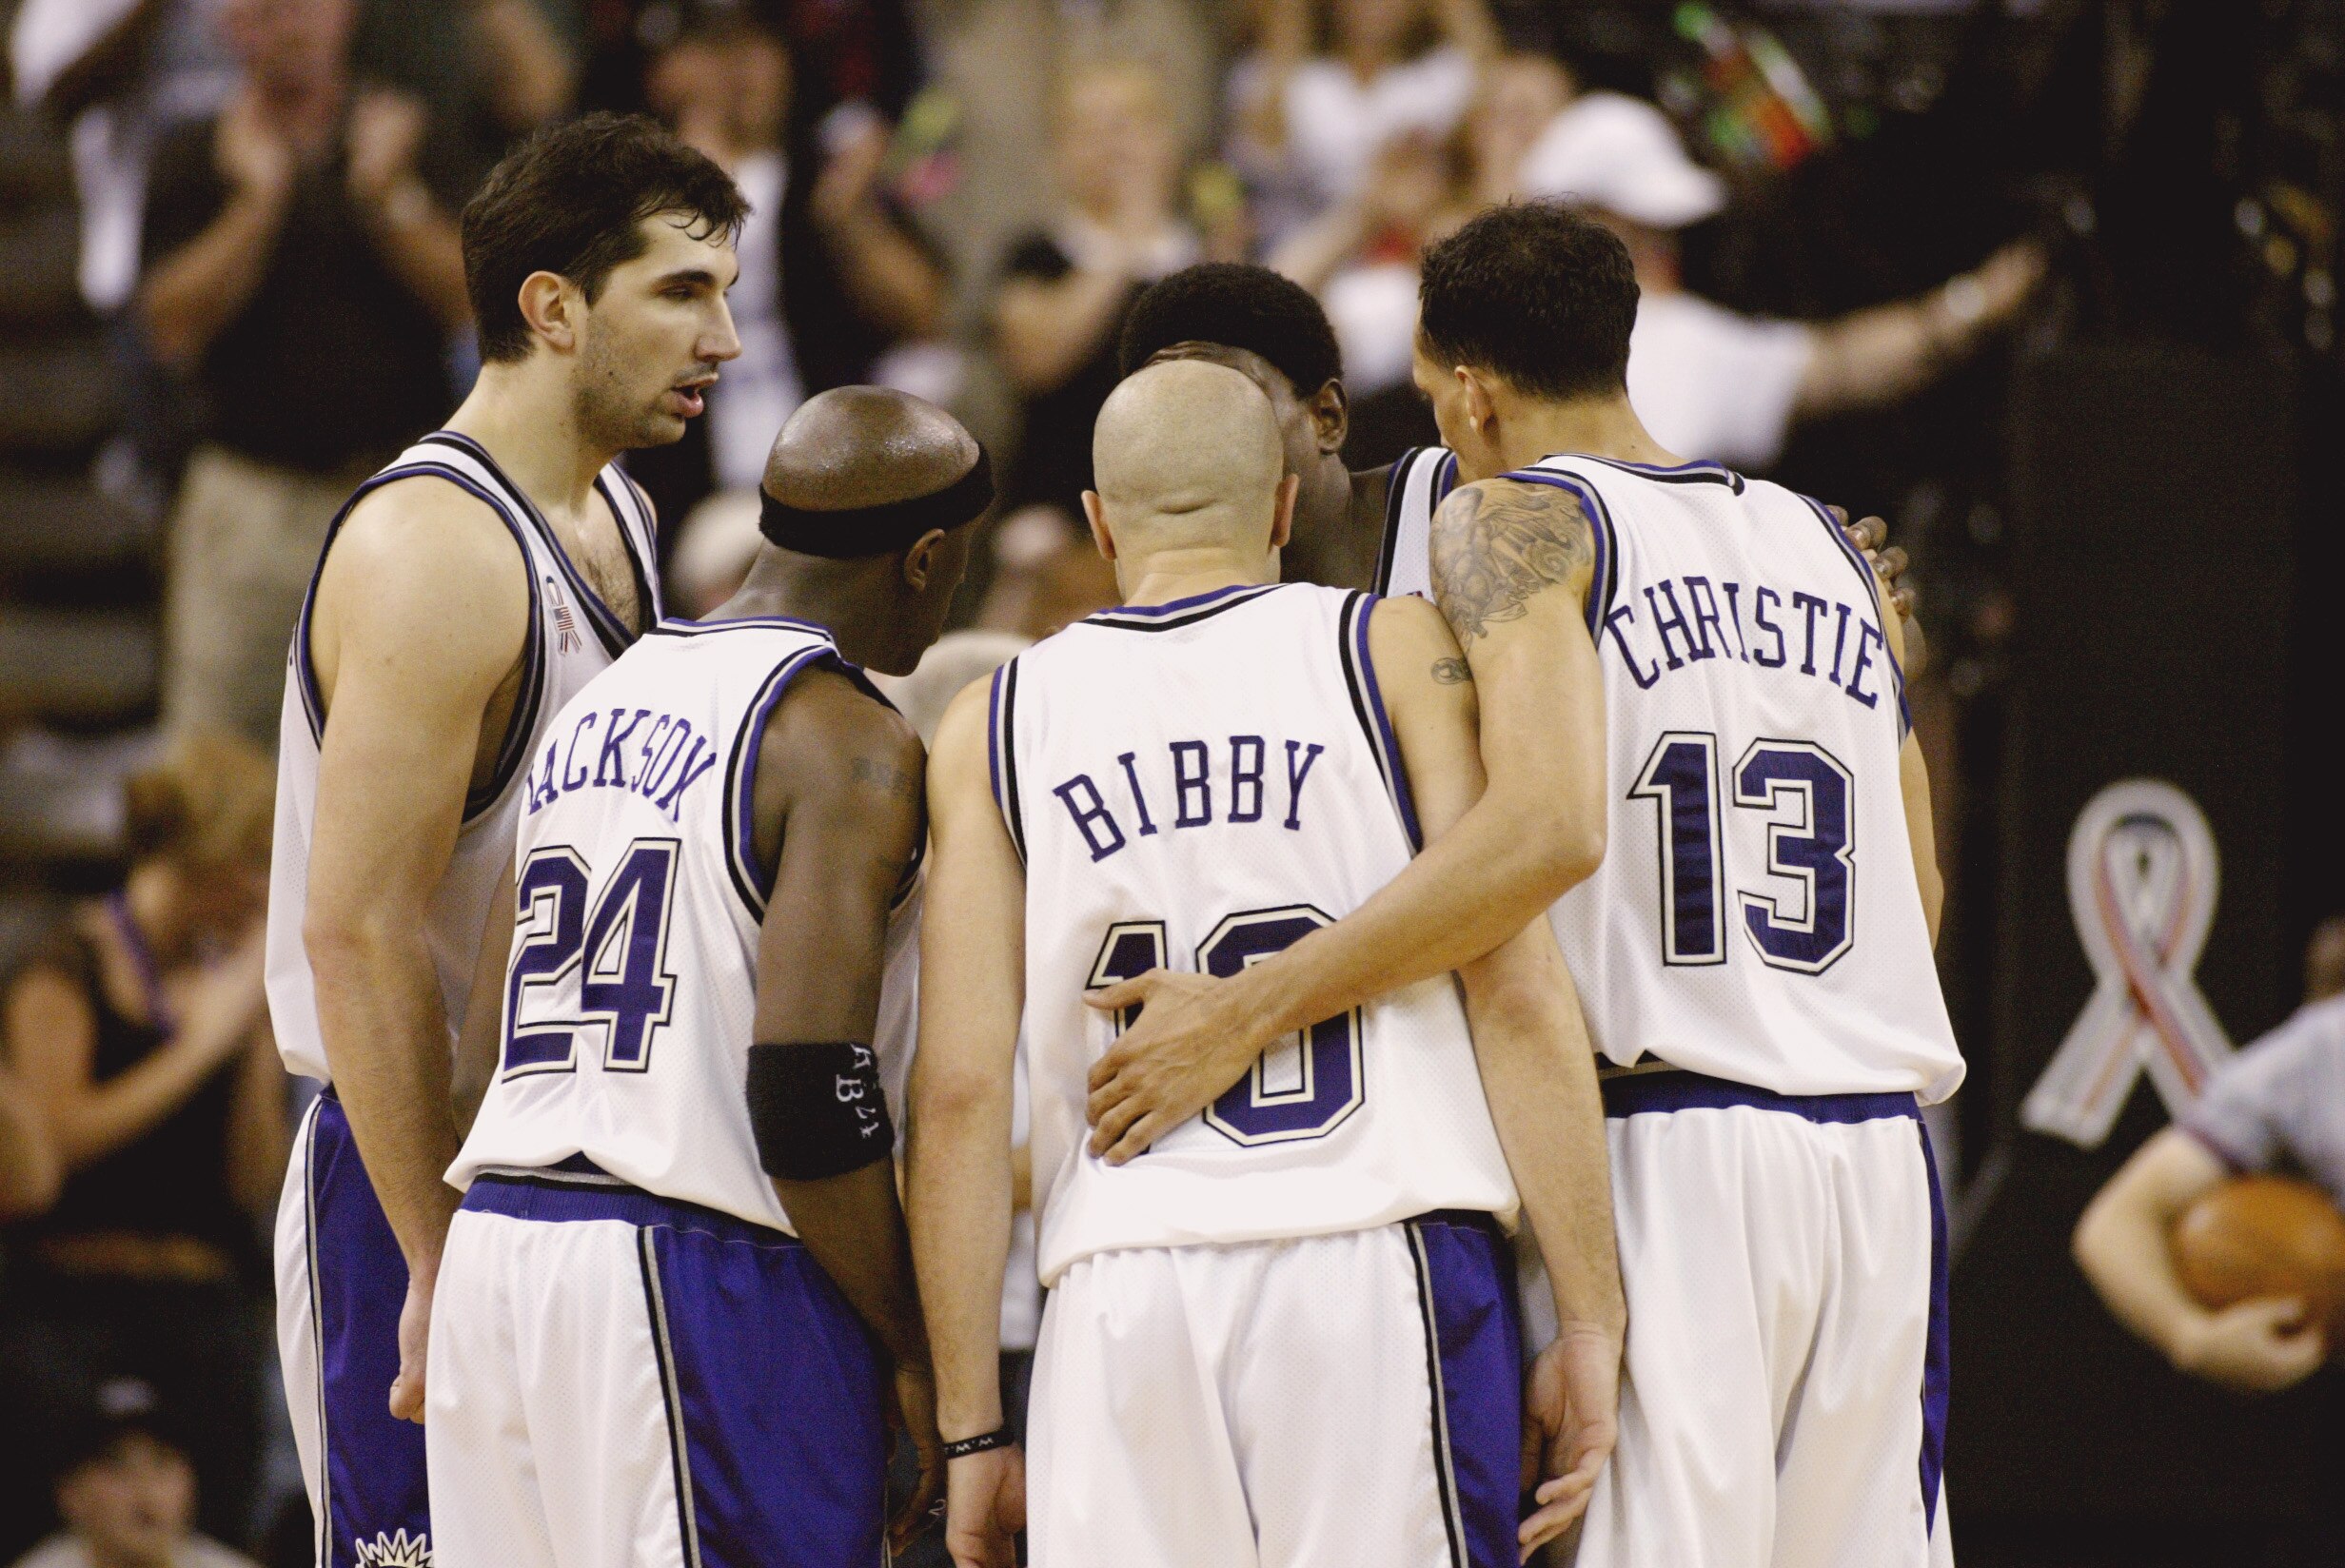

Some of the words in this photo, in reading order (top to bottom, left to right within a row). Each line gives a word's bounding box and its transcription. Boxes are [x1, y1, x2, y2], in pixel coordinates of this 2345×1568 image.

[1605, 577, 1883, 710] CHRISTIE
[1053, 735, 1325, 863] BIBBY
[1626, 731, 1856, 976] 13
[502, 837, 681, 1084] 24
